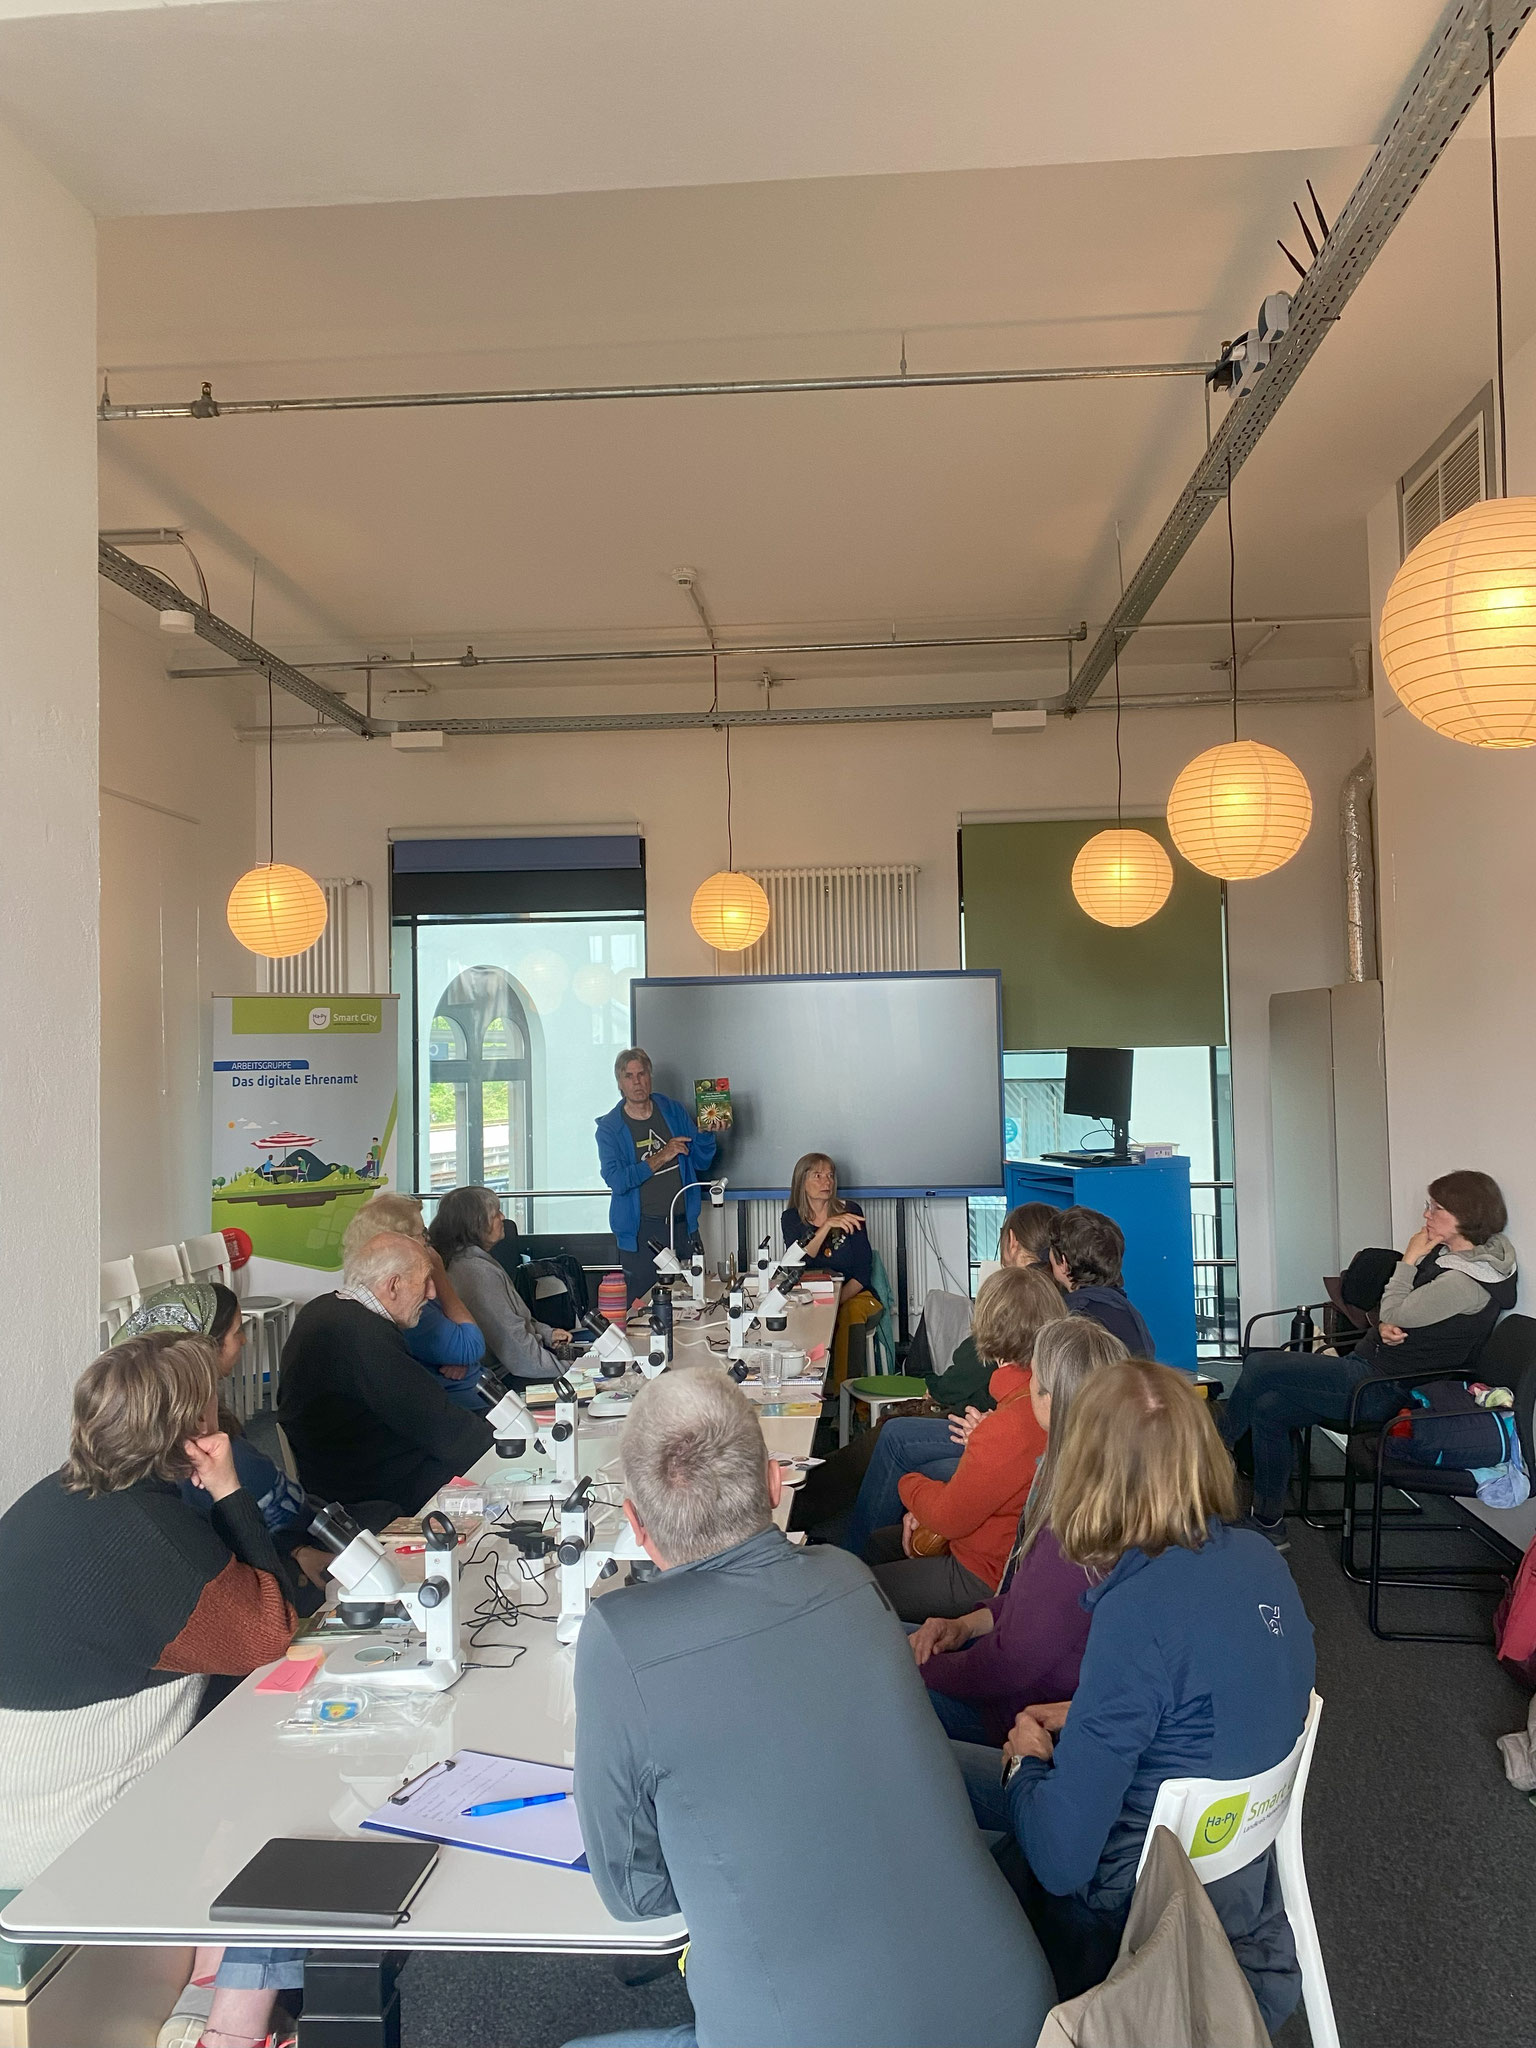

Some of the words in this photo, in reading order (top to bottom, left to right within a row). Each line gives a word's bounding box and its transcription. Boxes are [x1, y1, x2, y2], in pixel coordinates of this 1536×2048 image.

[333, 1013, 359, 1022] Smart
[360, 1013, 377, 1023] City
[231, 1061, 292, 1070] ARBEITSGRUPPE
[232, 1076, 254, 1087] Das
[257, 1074, 301, 1088] digitale
[304, 1073, 358, 1085] Ehrenamt
[1206, 1812, 1238, 1828] Ha-Py
